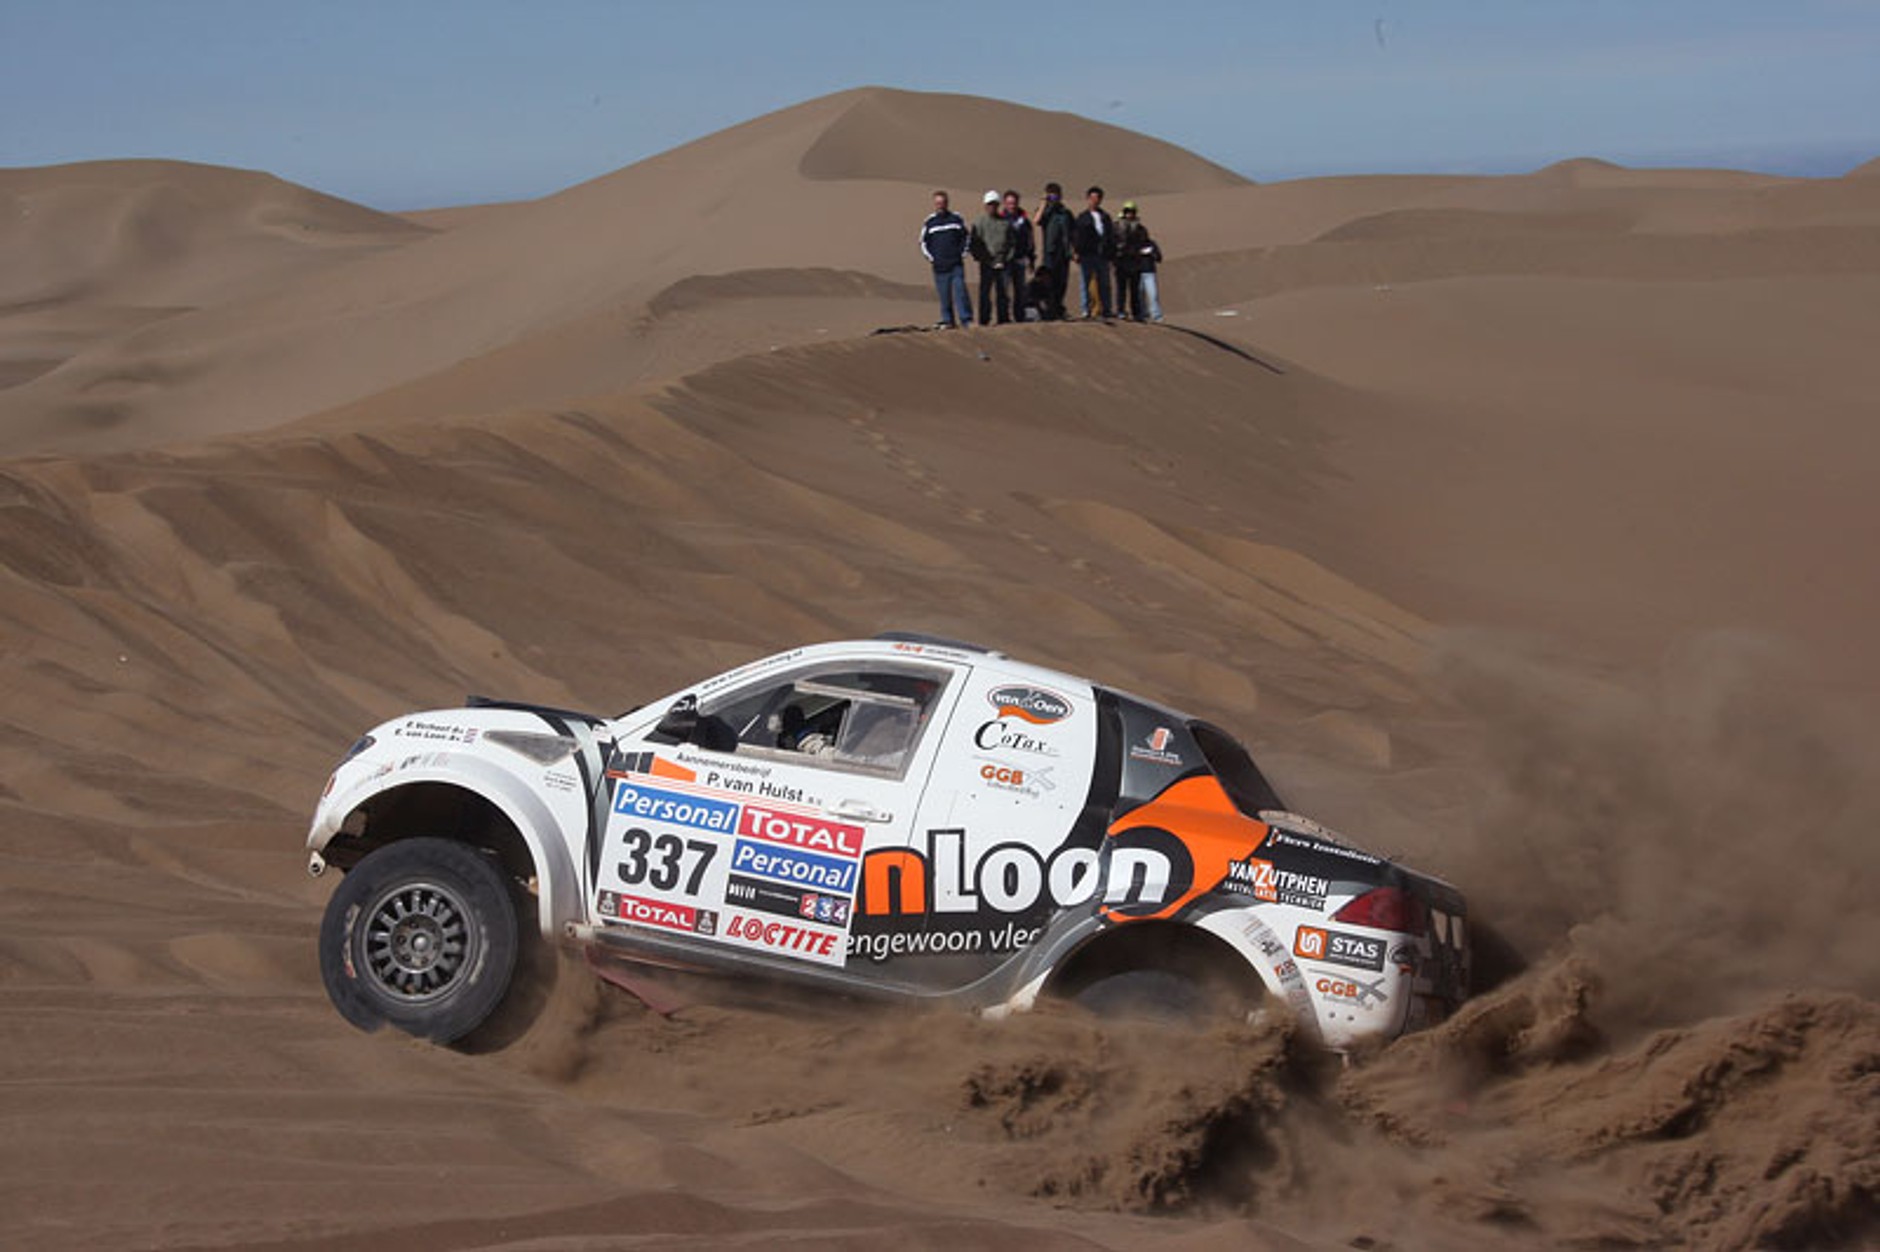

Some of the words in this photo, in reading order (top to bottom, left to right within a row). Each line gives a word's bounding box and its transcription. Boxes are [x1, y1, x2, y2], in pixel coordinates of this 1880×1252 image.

[617, 789, 735, 831] Personal
[724, 777, 754, 793] van
[759, 780, 803, 803] Hulst
[746, 808, 857, 855] TOTAL
[617, 828, 718, 897] 337
[735, 845, 852, 889] Personal
[853, 829, 1172, 915] nLoon
[622, 900, 694, 928] TOTAL
[726, 914, 838, 956] LOCTITE
[1331, 937, 1378, 958] STAS
